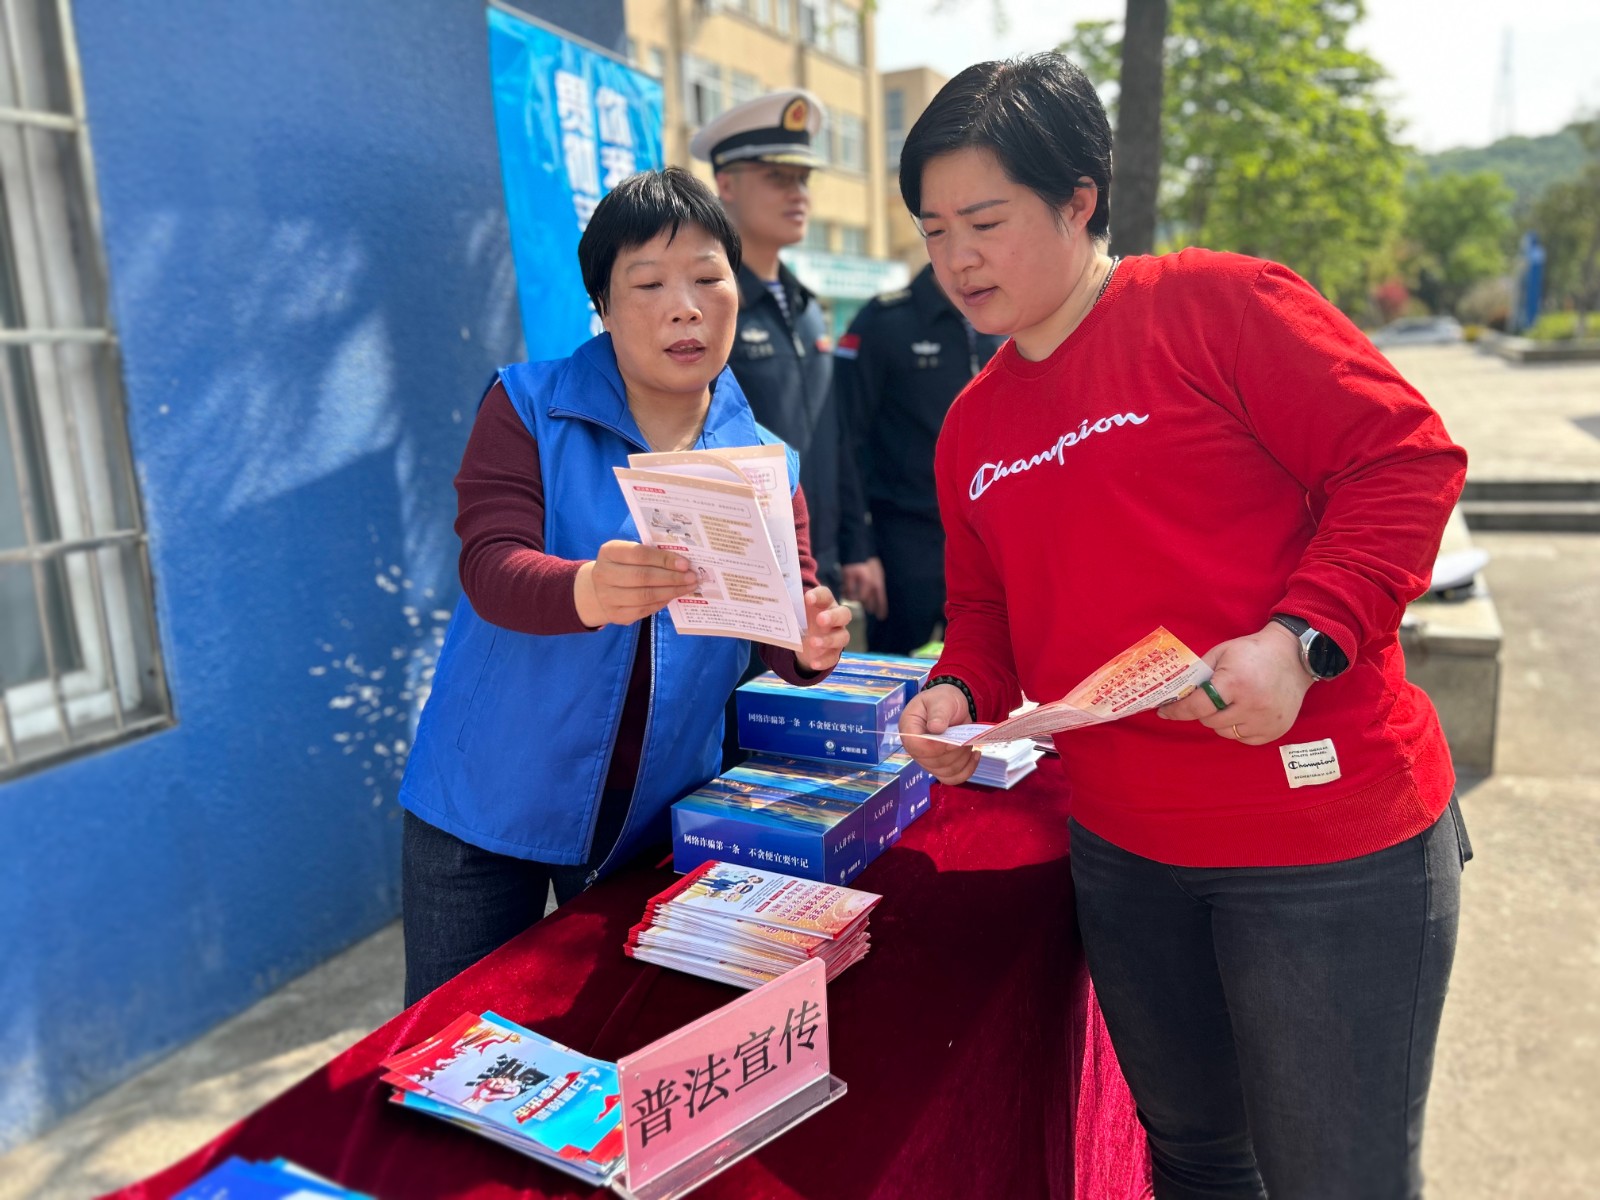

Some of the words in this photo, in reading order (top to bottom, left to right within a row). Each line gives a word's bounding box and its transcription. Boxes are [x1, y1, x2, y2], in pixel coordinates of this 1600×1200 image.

[969, 412, 1149, 501] Champion
[748, 712, 801, 727] 网络诈骗第一条
[808, 720, 864, 734] 不贪便宜要牢记
[1288, 758, 1336, 770] Champion
[683, 833, 740, 855] 网络诈骗第一条
[748, 847, 809, 869] 不贪便宜要牢记
[629, 1000, 822, 1149] 普法宣传
